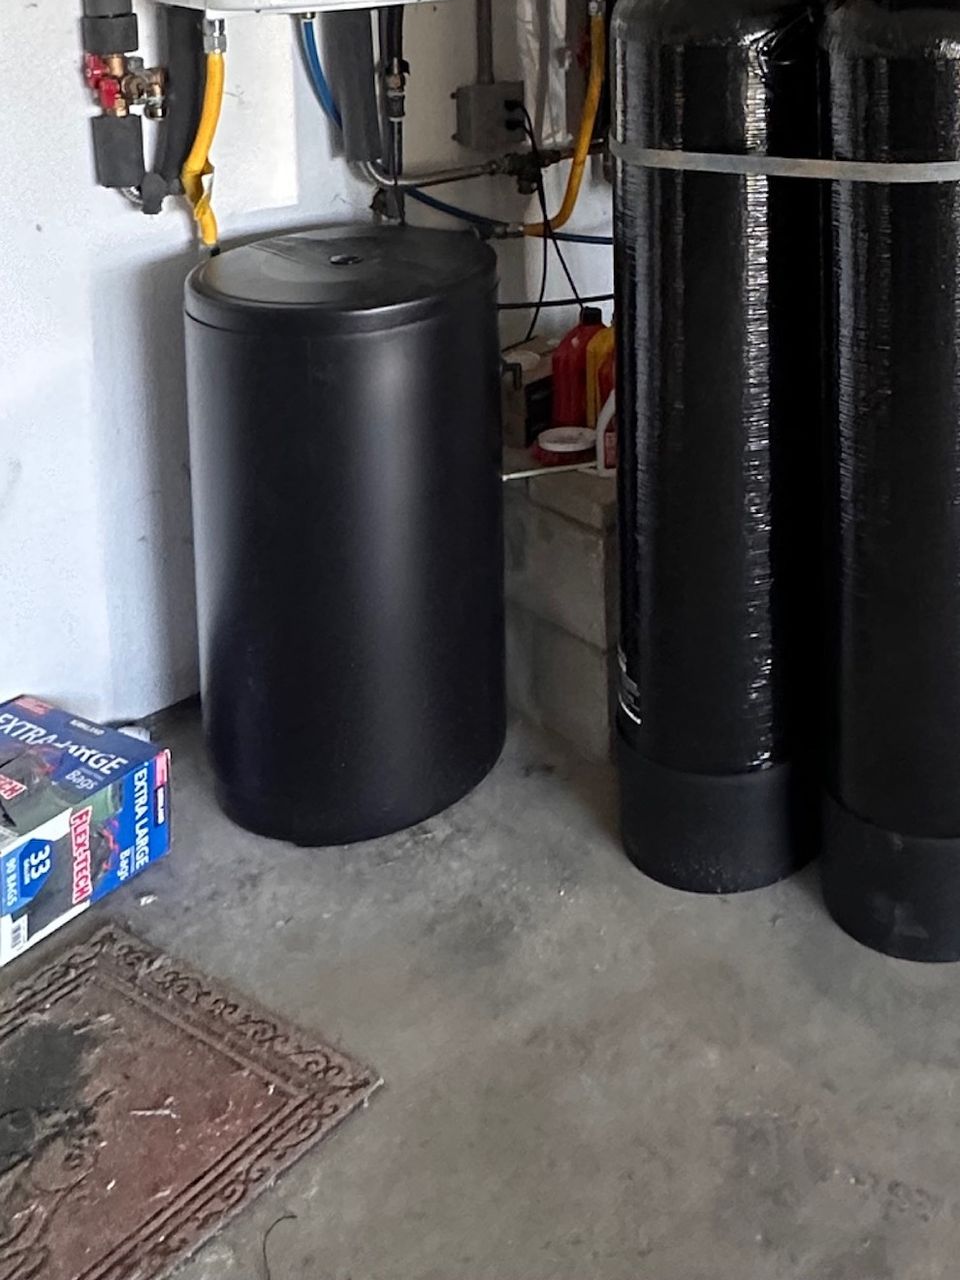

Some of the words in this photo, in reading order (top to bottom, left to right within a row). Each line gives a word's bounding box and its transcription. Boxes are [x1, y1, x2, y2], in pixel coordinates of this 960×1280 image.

[0, 713, 58, 745] EXTRA
[65, 769, 98, 790] Bags
[134, 768, 149, 819] EXTRA
[72, 808, 91, 903] FLEX-TECH
[135, 820, 150, 870] LARGE
[30, 845, 51, 880] 33
[117, 849, 130, 881] Bags
[6, 875, 18, 907] BAGS
